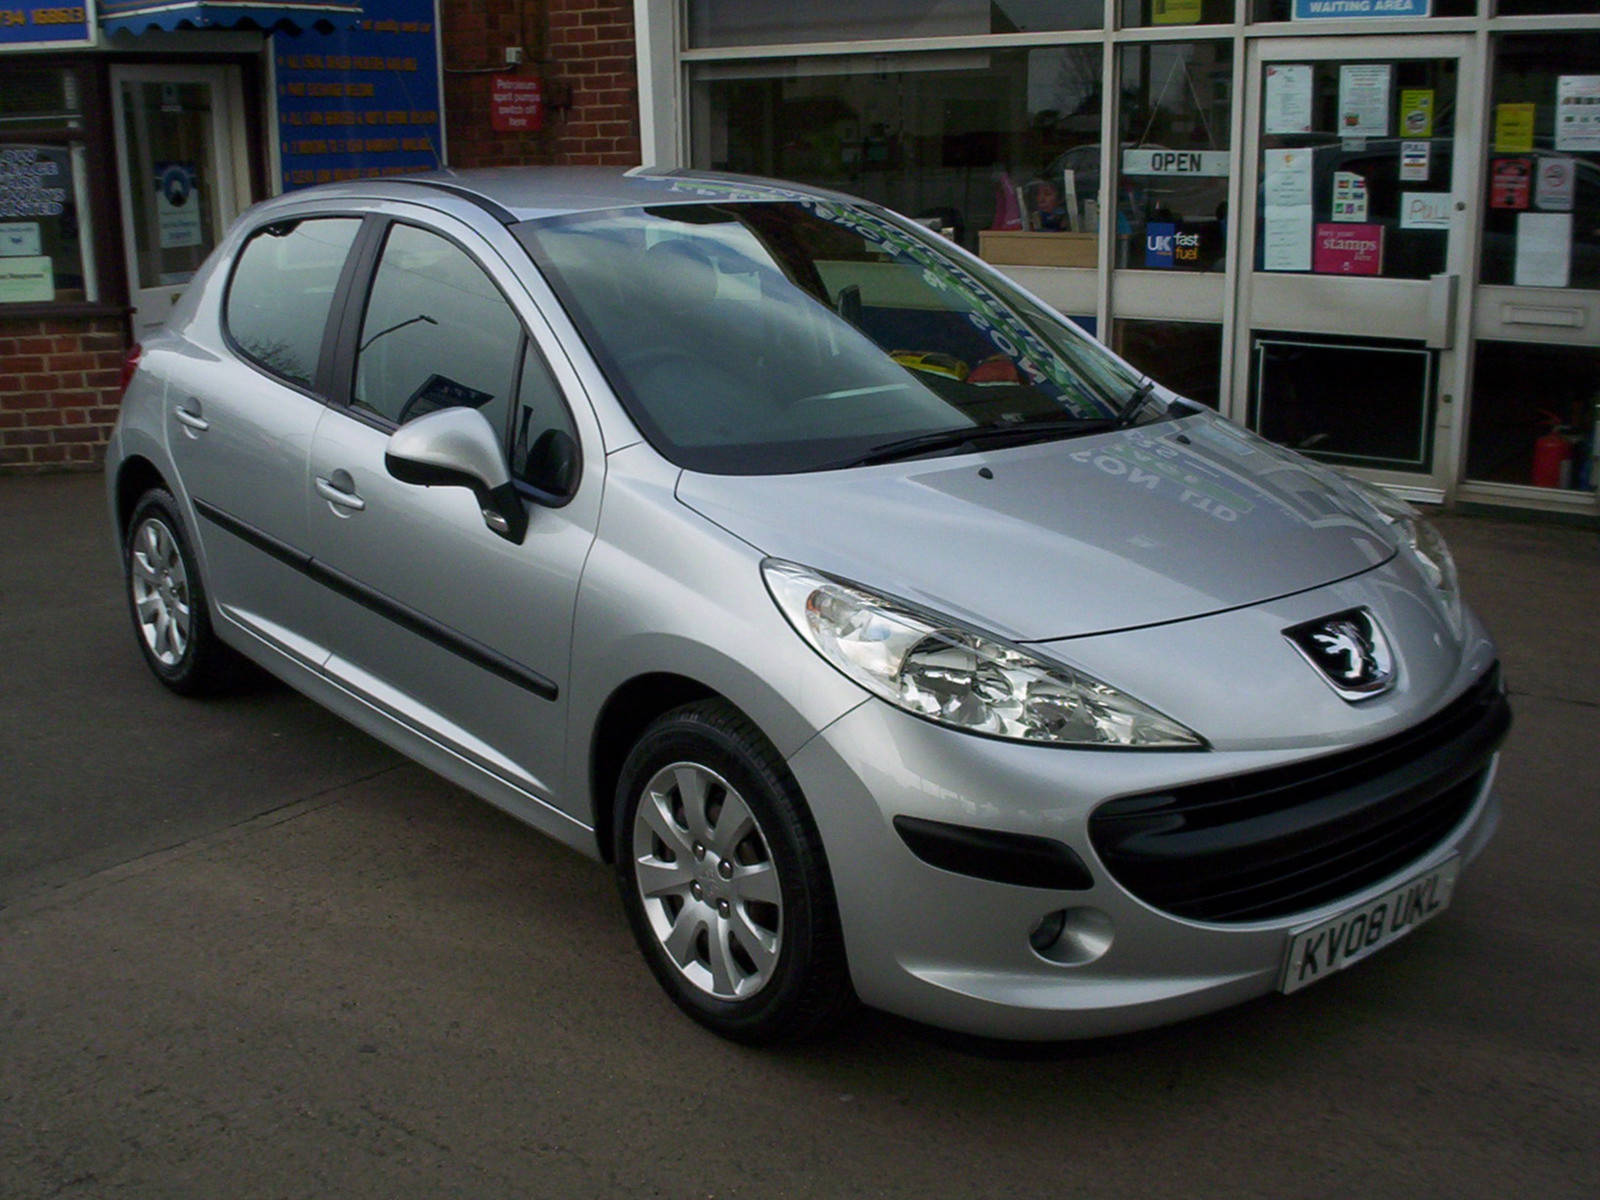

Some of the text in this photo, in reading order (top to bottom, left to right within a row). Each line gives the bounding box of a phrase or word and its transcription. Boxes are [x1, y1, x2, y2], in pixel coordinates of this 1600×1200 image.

[1309, 0, 1413, 13] WAITING AREA
[1151, 153, 1202, 172] OPEN
[1147, 231, 1199, 251] UK fast
[1323, 238, 1377, 255] stamps
[1175, 247, 1198, 260] fuel
[1298, 874, 1440, 981] KV08 UKL
